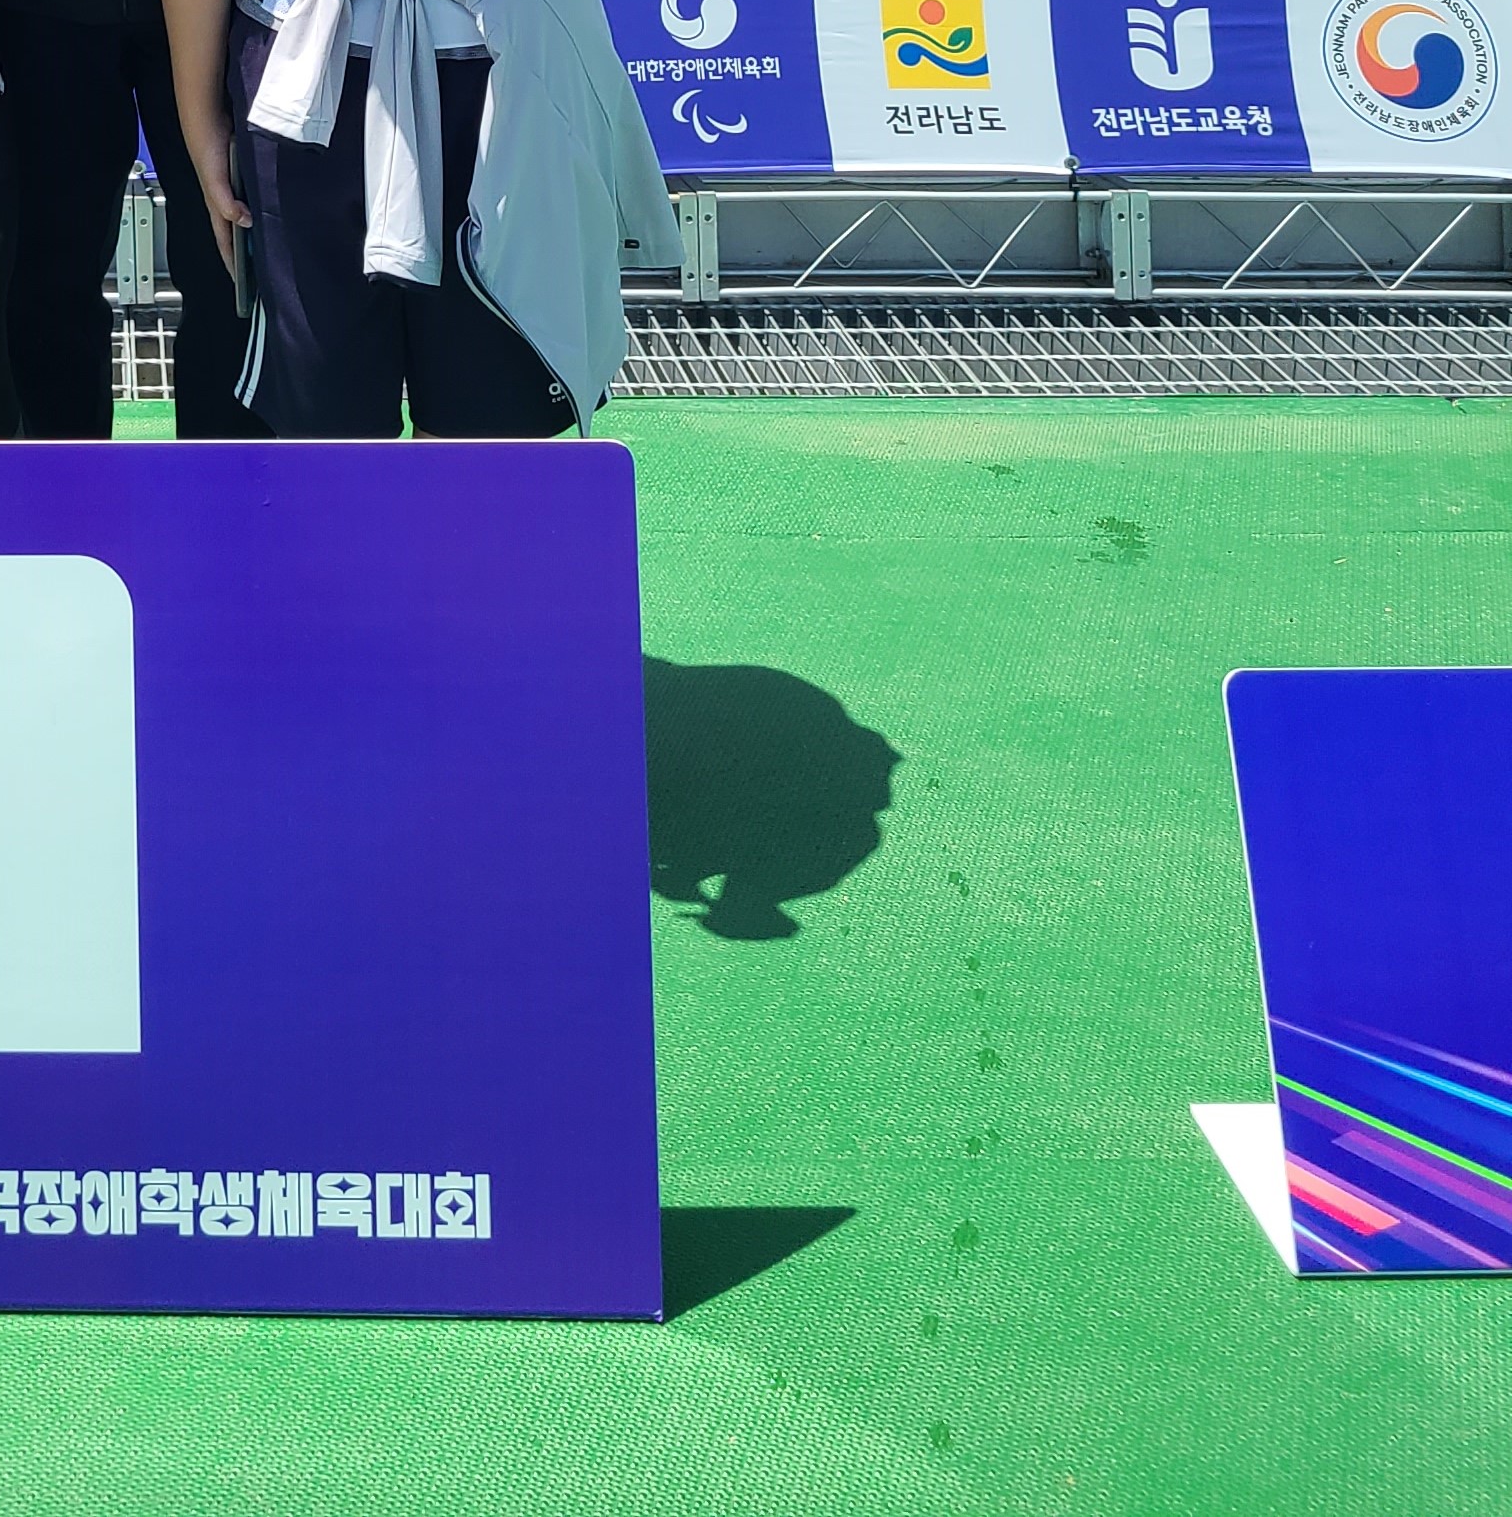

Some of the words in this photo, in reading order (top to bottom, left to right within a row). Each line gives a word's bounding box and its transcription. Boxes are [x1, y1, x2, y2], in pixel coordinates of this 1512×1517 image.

[1333, 14, 1351, 78] JEONNAM
[628, 57, 780, 81] 대한장애인체육회
[886, 106, 1006, 134] 전라남도
[1093, 106, 1272, 136] 전라남도교육청
[1353, 90, 1480, 133] 전라남도장애인체육회
